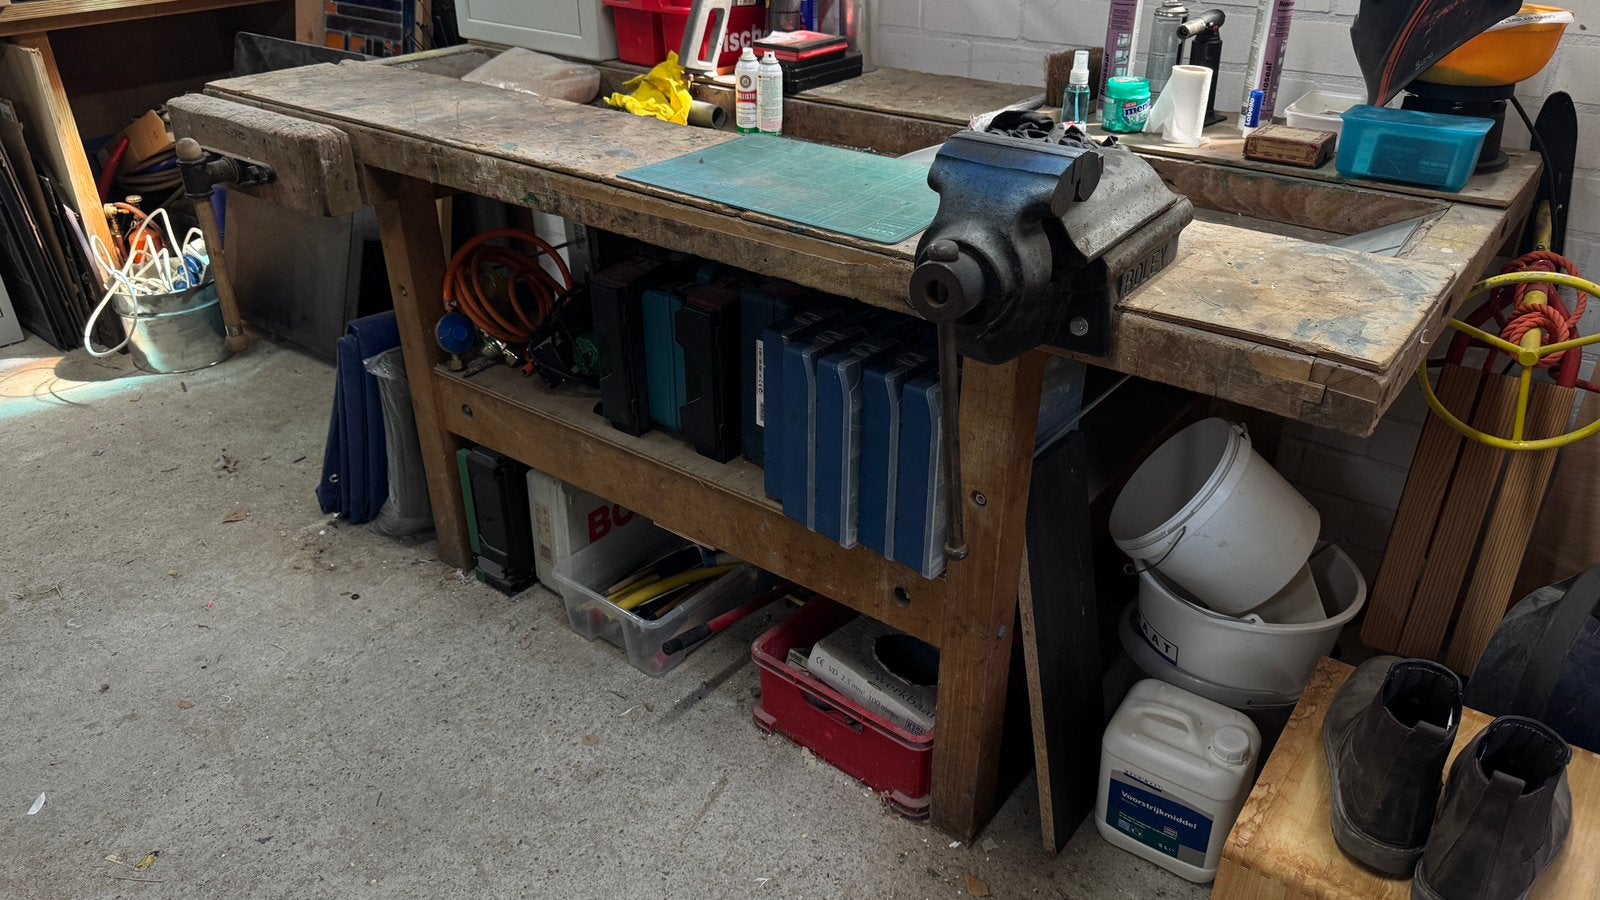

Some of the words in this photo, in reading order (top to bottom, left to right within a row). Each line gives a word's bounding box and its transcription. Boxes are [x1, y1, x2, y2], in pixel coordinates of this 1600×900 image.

[723, 24, 768, 53] isch
[1139, 613, 1171, 654] AAT
[828, 665, 838, 676] VD
[869, 695, 880, 707] 100
[880, 704, 899, 720] meter
[1121, 790, 1197, 830] Voorstrijkmiddel
